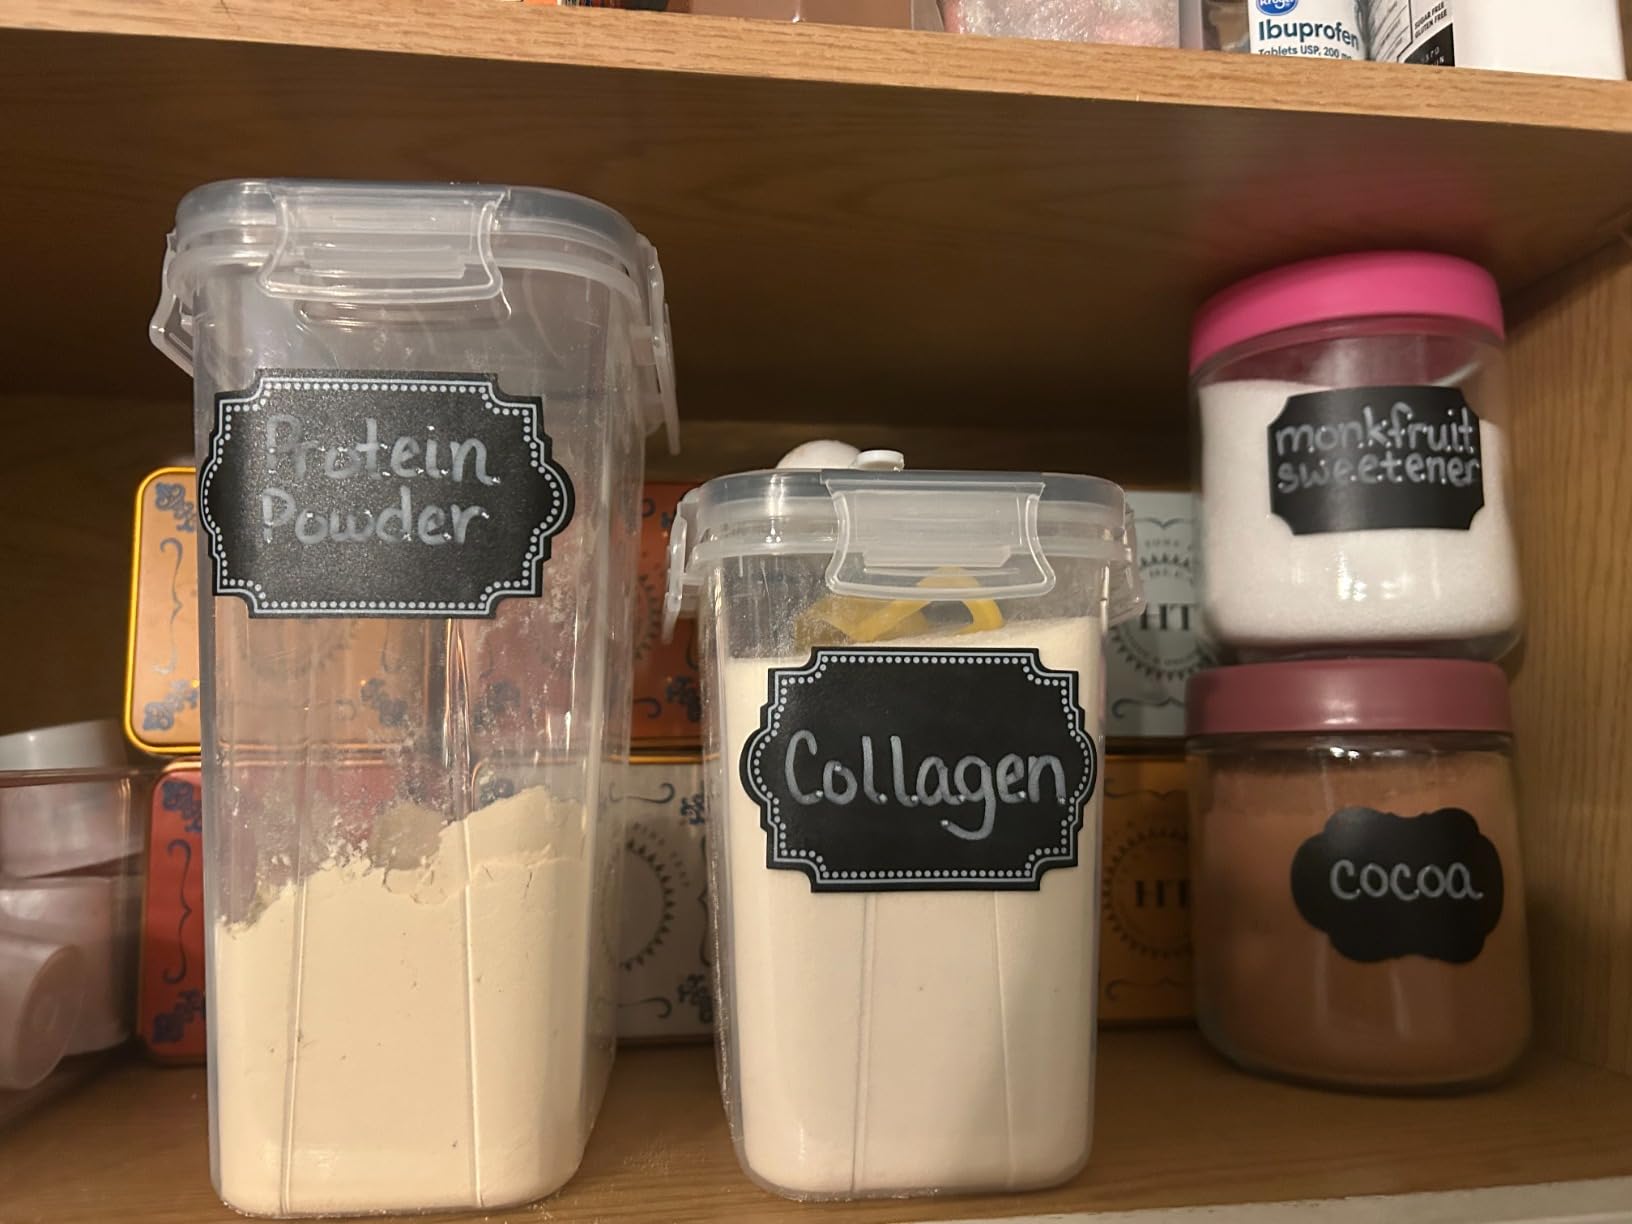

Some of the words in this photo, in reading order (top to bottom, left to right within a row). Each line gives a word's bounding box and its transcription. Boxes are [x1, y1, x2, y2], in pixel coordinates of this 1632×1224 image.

[1258, 18, 1360, 51] Ibuprofen
[1414, 10, 1431, 30] SUGAR
[1431, 1, 1445, 16] FREE
[1415, 19, 1434, 38] GLUTEN
[1434, 9, 1447, 24] FREE
[1258, 46, 1298, 56] Tablets
[1324, 47, 1340, 58] 200
[265, 414, 500, 486] Protein
[1276, 401, 1475, 456] monkfruit
[1277, 451, 1480, 494] sweetener
[261, 485, 490, 545] Powder
[785, 729, 1067, 841] Collagen
